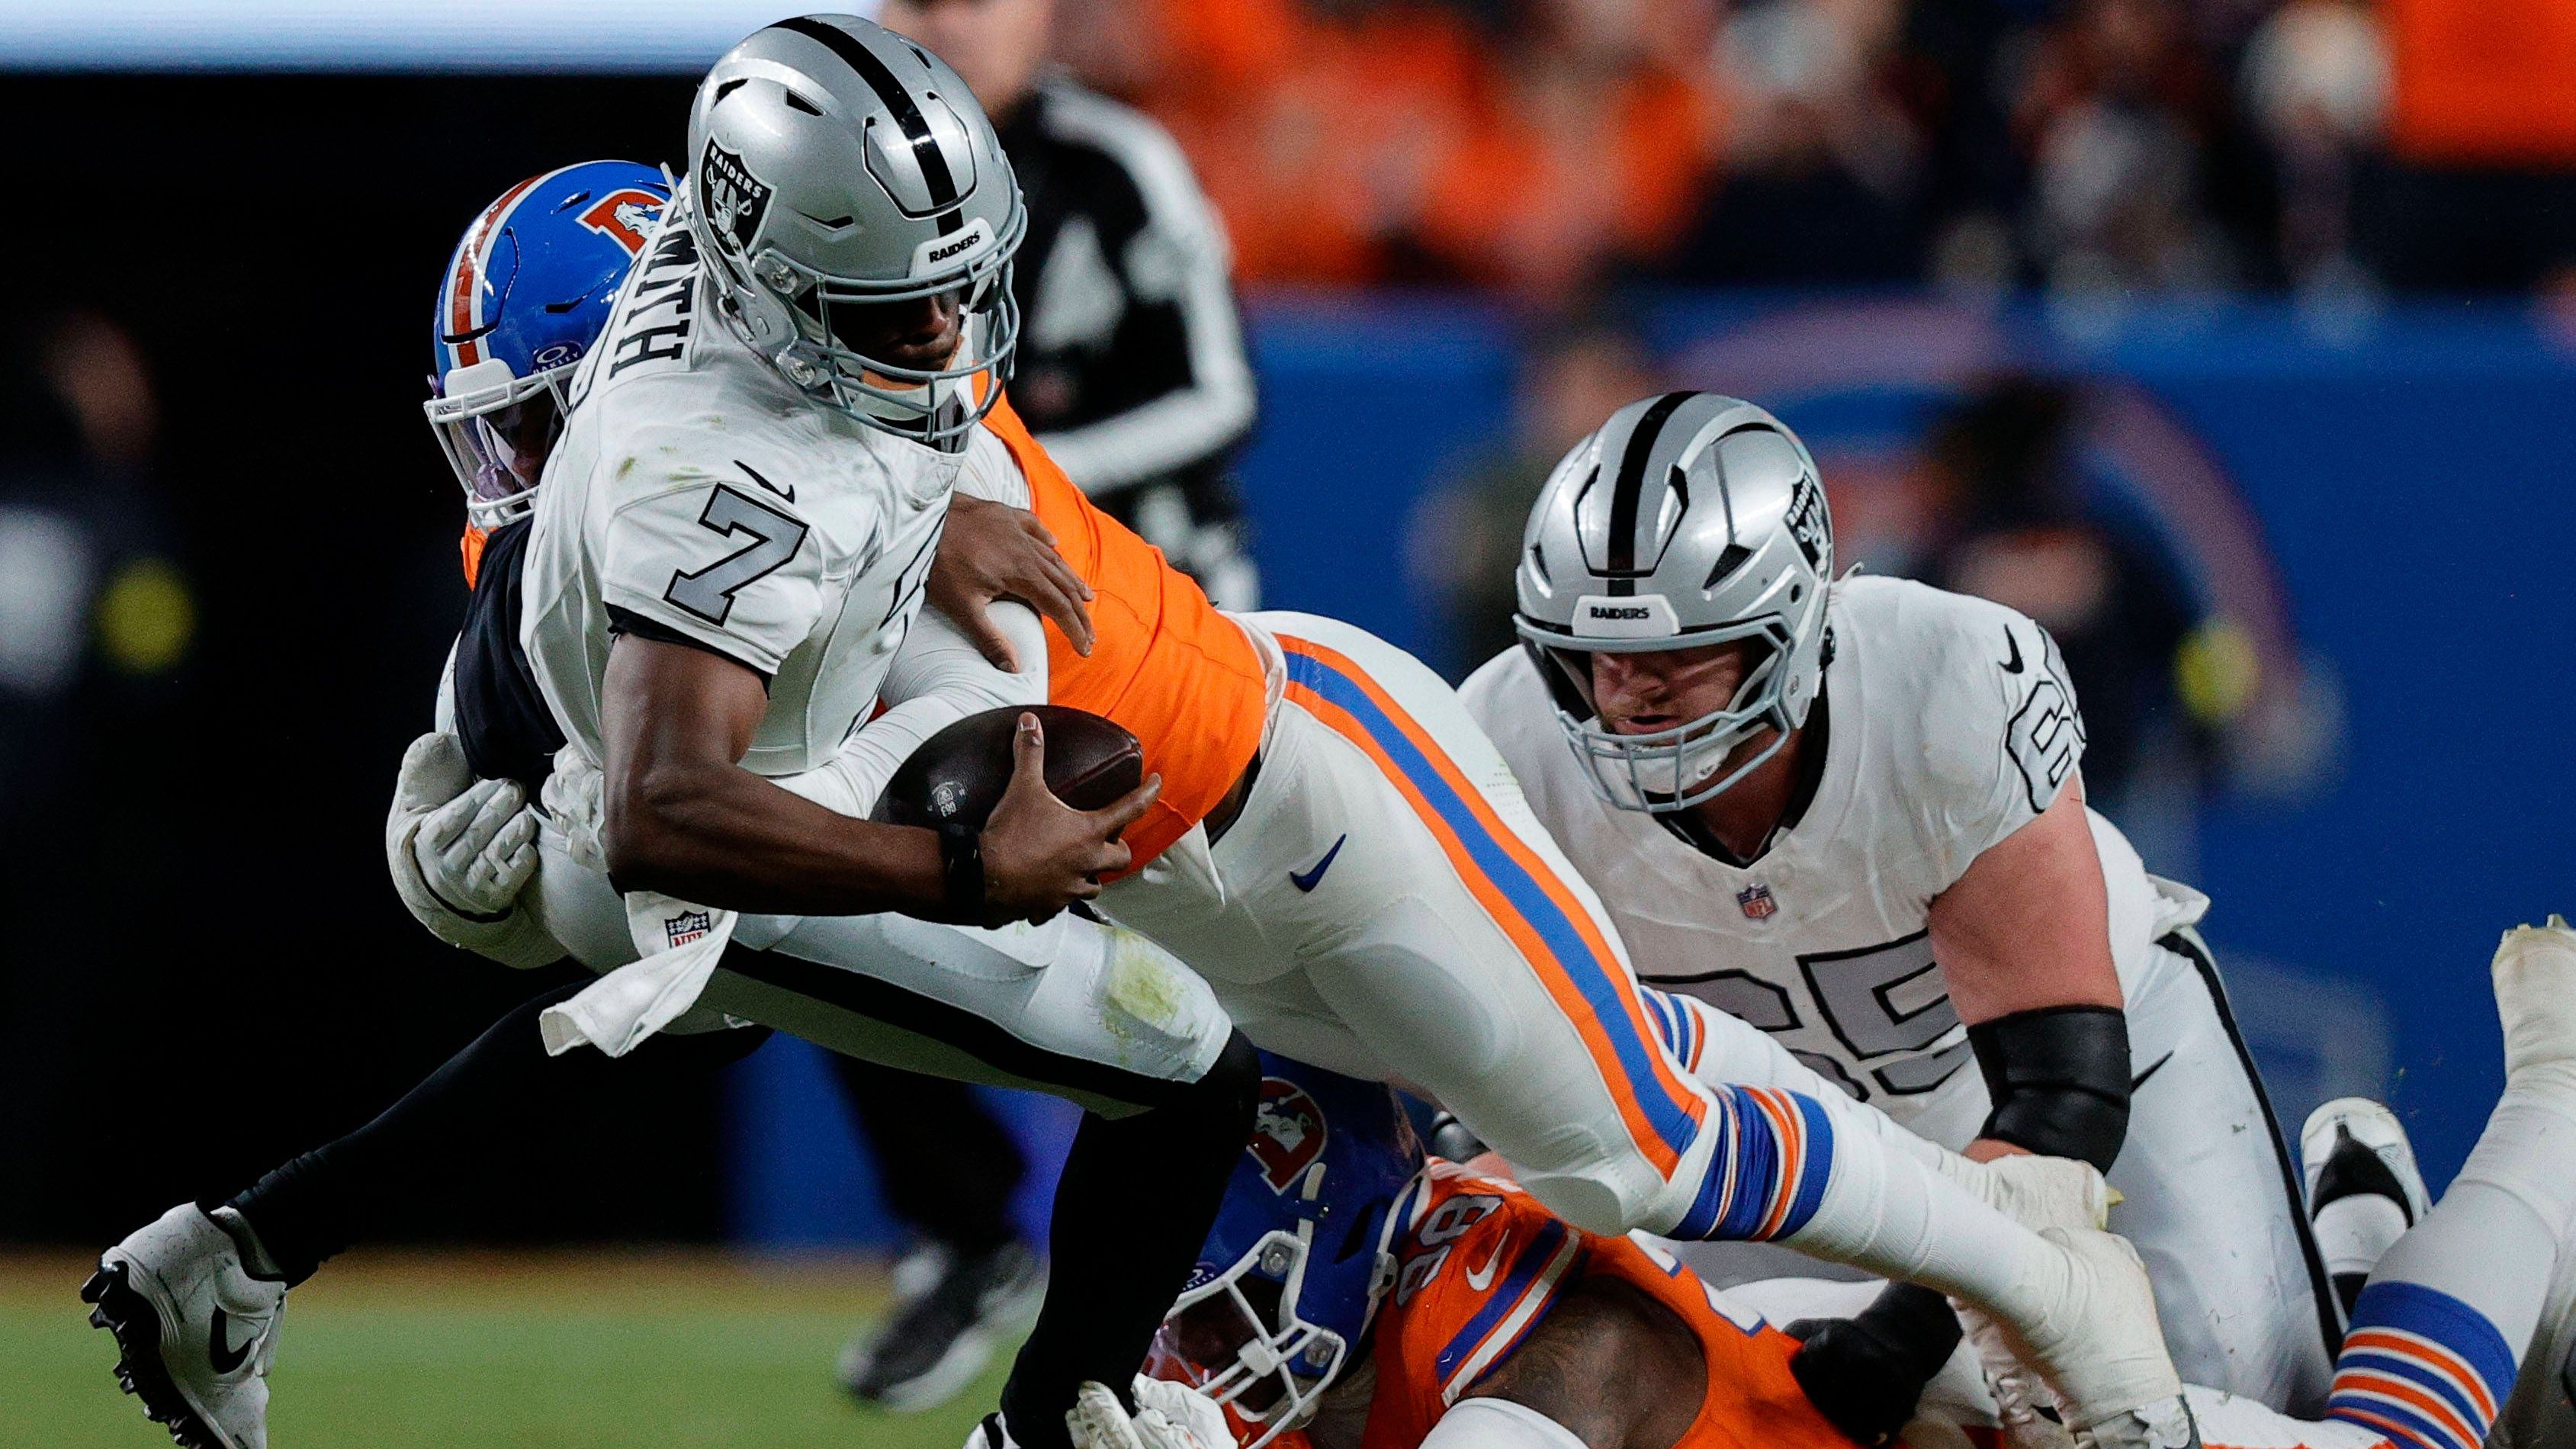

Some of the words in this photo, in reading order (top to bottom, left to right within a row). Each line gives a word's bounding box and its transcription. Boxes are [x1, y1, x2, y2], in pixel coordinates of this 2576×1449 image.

[709, 145, 763, 198] RAIDERS
[929, 230, 980, 263] RAIDERS
[663, 483, 810, 627] 7
[1590, 606, 1649, 619] RAIDERS
